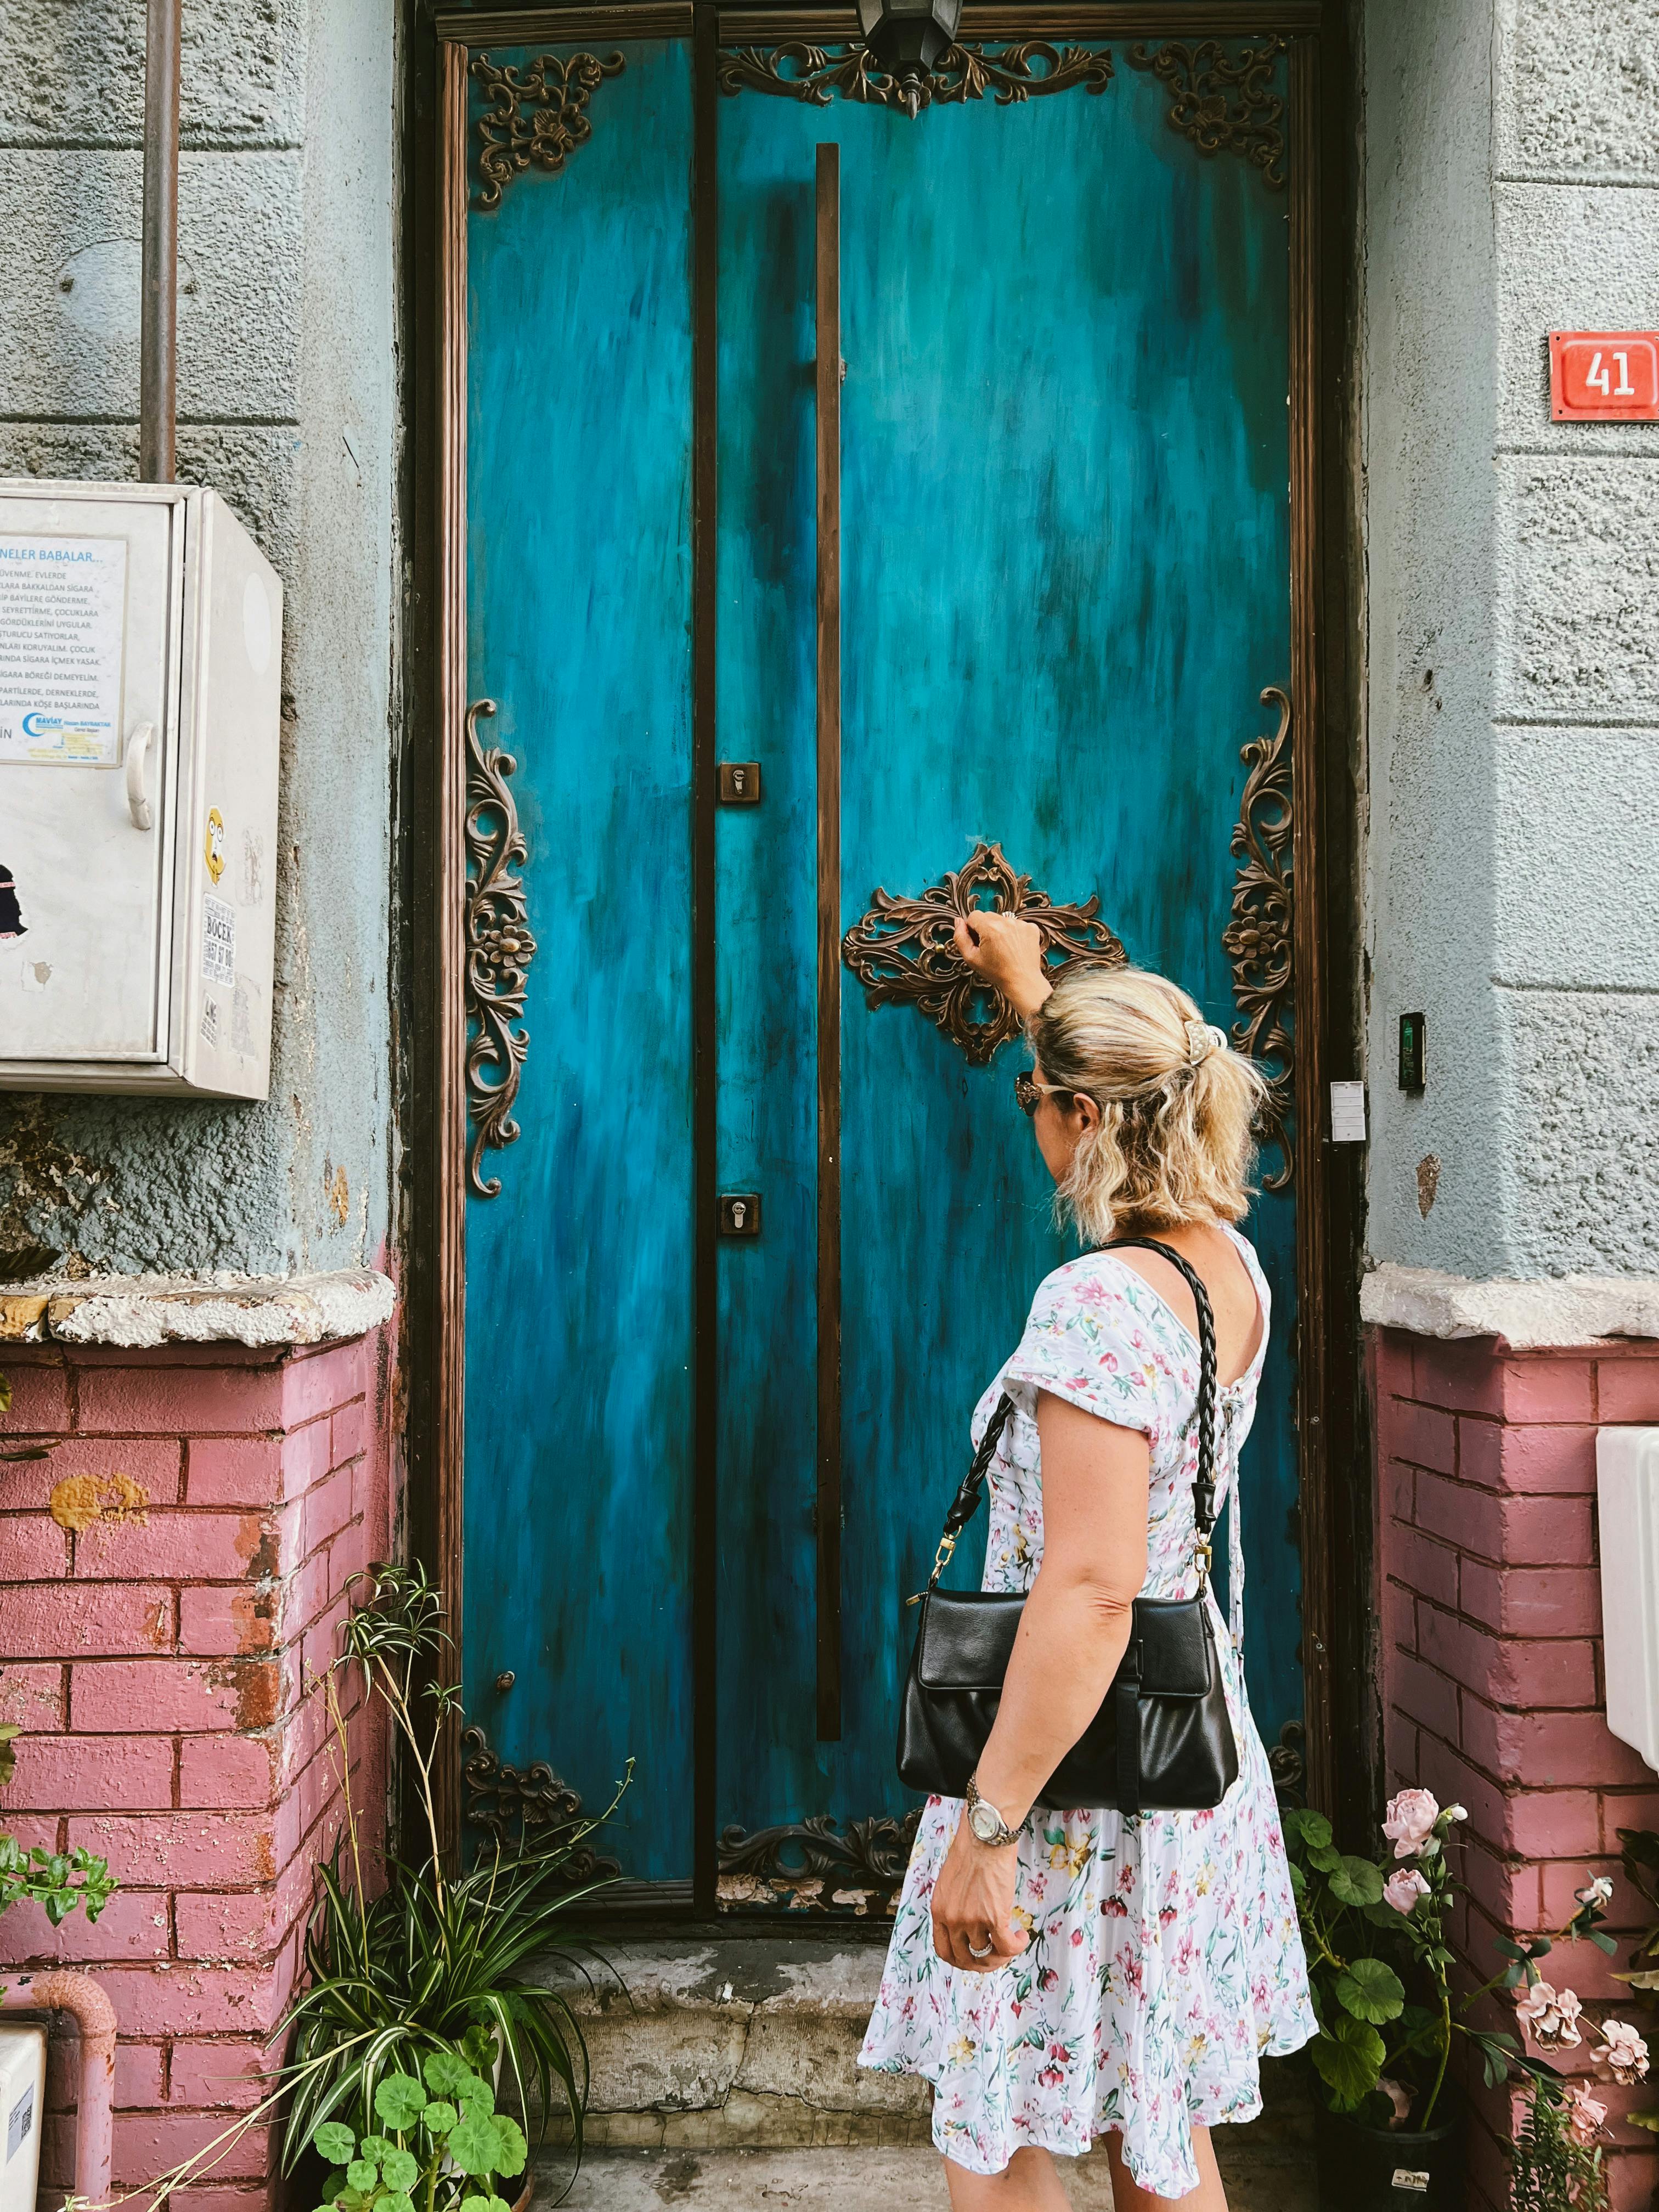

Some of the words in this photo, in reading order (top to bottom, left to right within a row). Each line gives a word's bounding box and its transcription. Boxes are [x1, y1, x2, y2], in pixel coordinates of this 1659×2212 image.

[1585, 352, 1635, 396] 41
[40, 550, 103, 562] BABALAR...
[67, 584, 93, 592] SİGARA
[10, 594, 43, 603] BAYİLERE
[55, 608, 99, 617] ÇOCUKLARA
[1, 618, 54, 627] GÖRDÜKLERİNİ
[70, 645, 95, 654] ÇOCUK
[23, 654, 49, 663] SİGARA
[52, 656, 75, 665] İÇMEK
[25, 670, 52, 680] BÖREĞİ
[34, 699, 52, 709] KÖŞE
[55, 702, 99, 710] BAŞLARINDA
